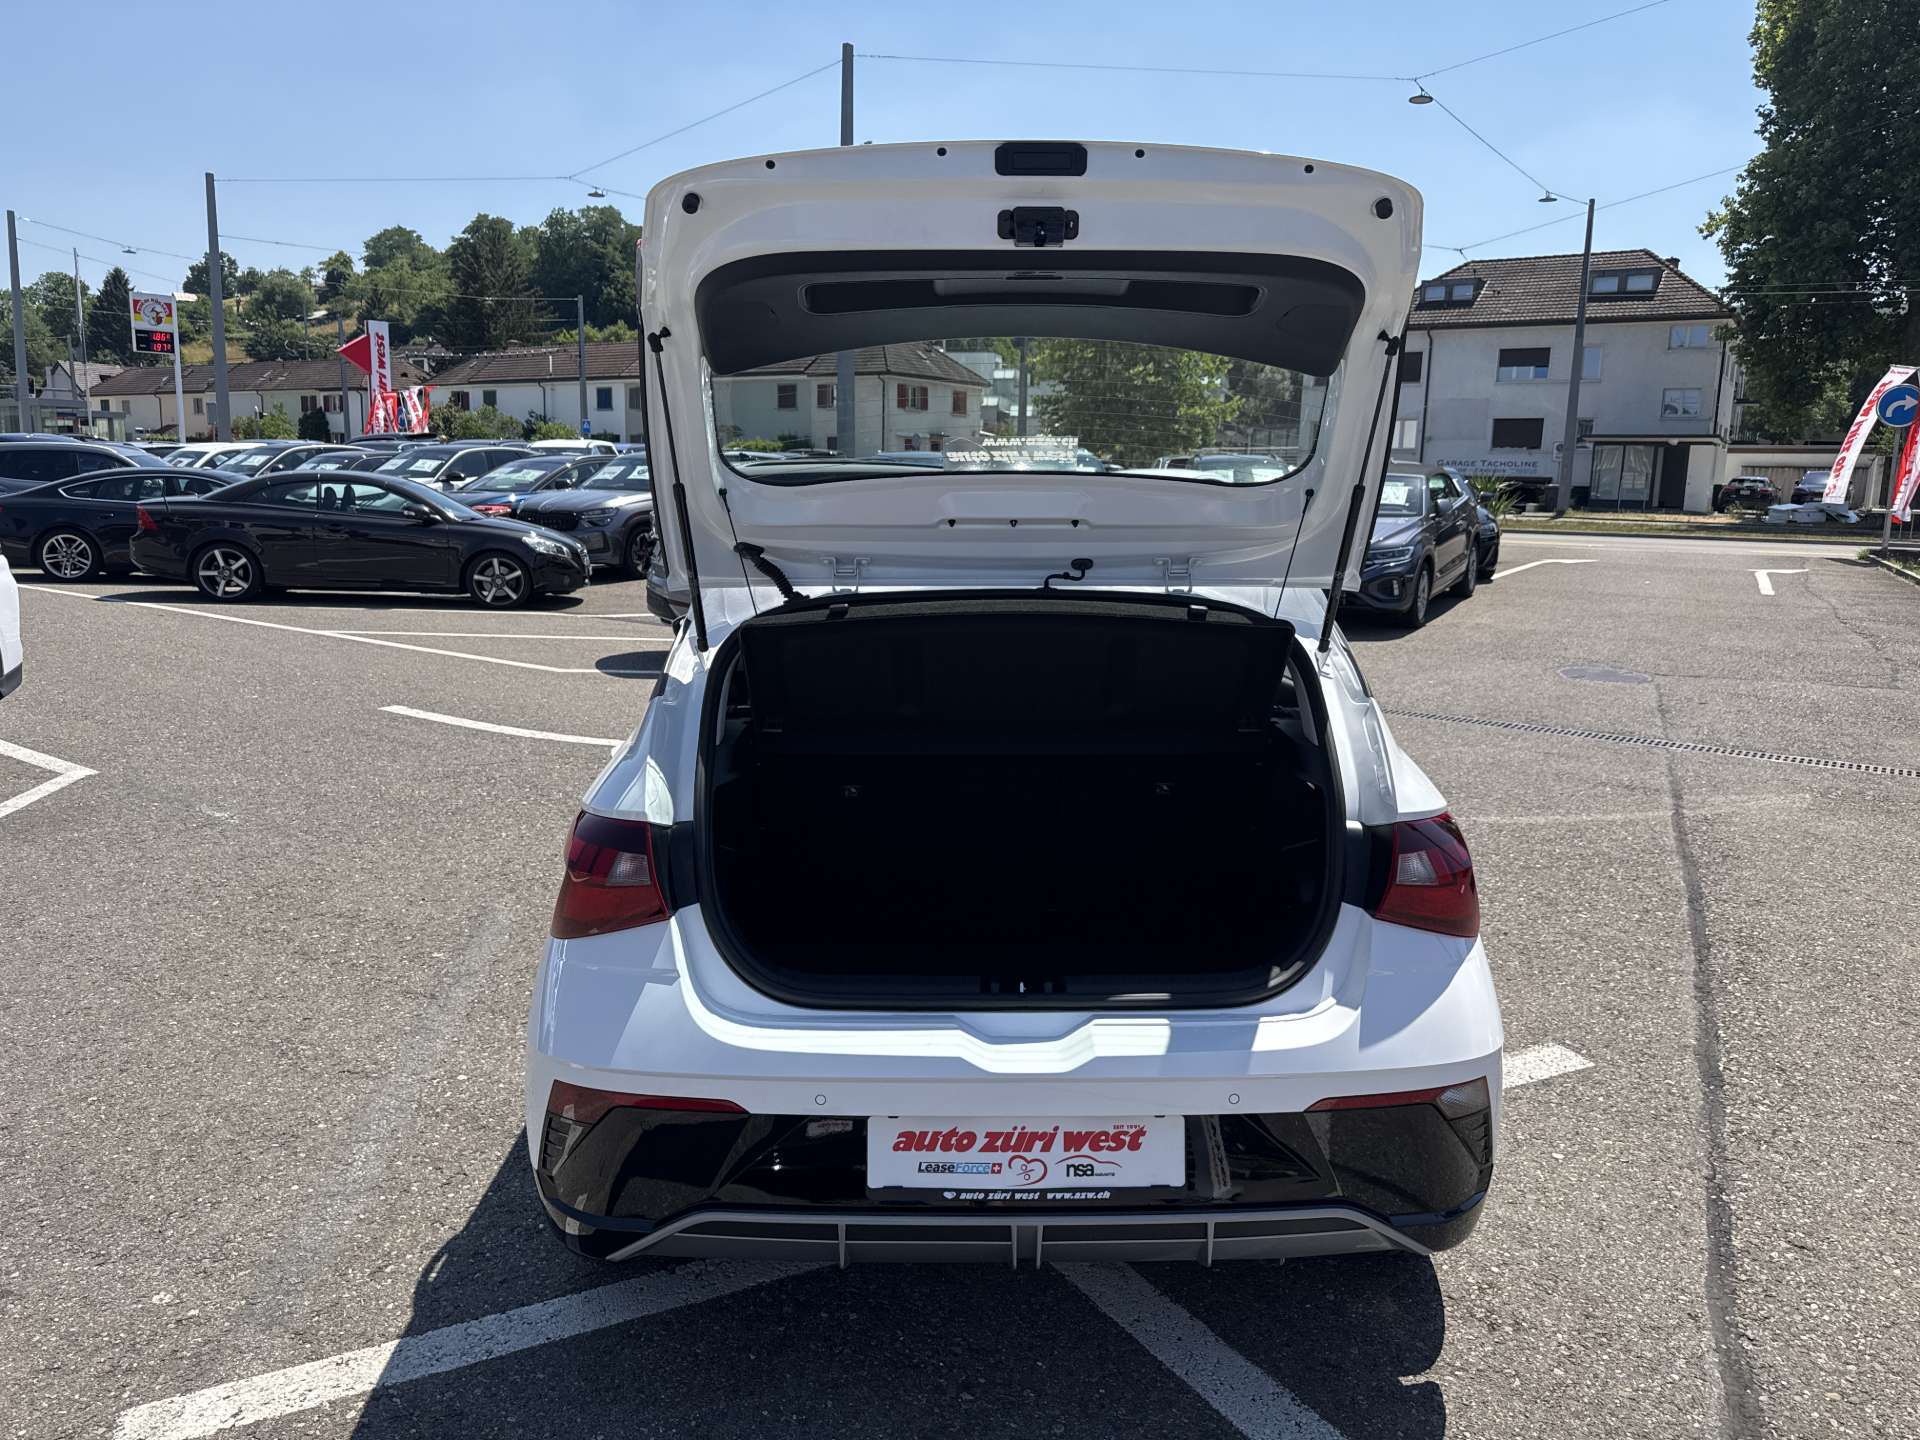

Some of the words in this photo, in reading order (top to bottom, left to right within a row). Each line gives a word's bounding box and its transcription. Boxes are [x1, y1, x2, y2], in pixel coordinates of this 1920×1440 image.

[375, 332, 386, 369] west
[1436, 459, 1475, 468] GARAGE
[1481, 460, 1538, 469] TACHOLINE
[892, 1126, 978, 1153] auto
[977, 1125, 1060, 1153] züri
[1063, 1125, 1147, 1153] west
[917, 1161, 991, 1174] LeaseForce
[1066, 1163, 1095, 1177] nsa
[959, 1191, 985, 1200] auto
[988, 1191, 1012, 1200] züri
[1014, 1191, 1041, 1200] west
